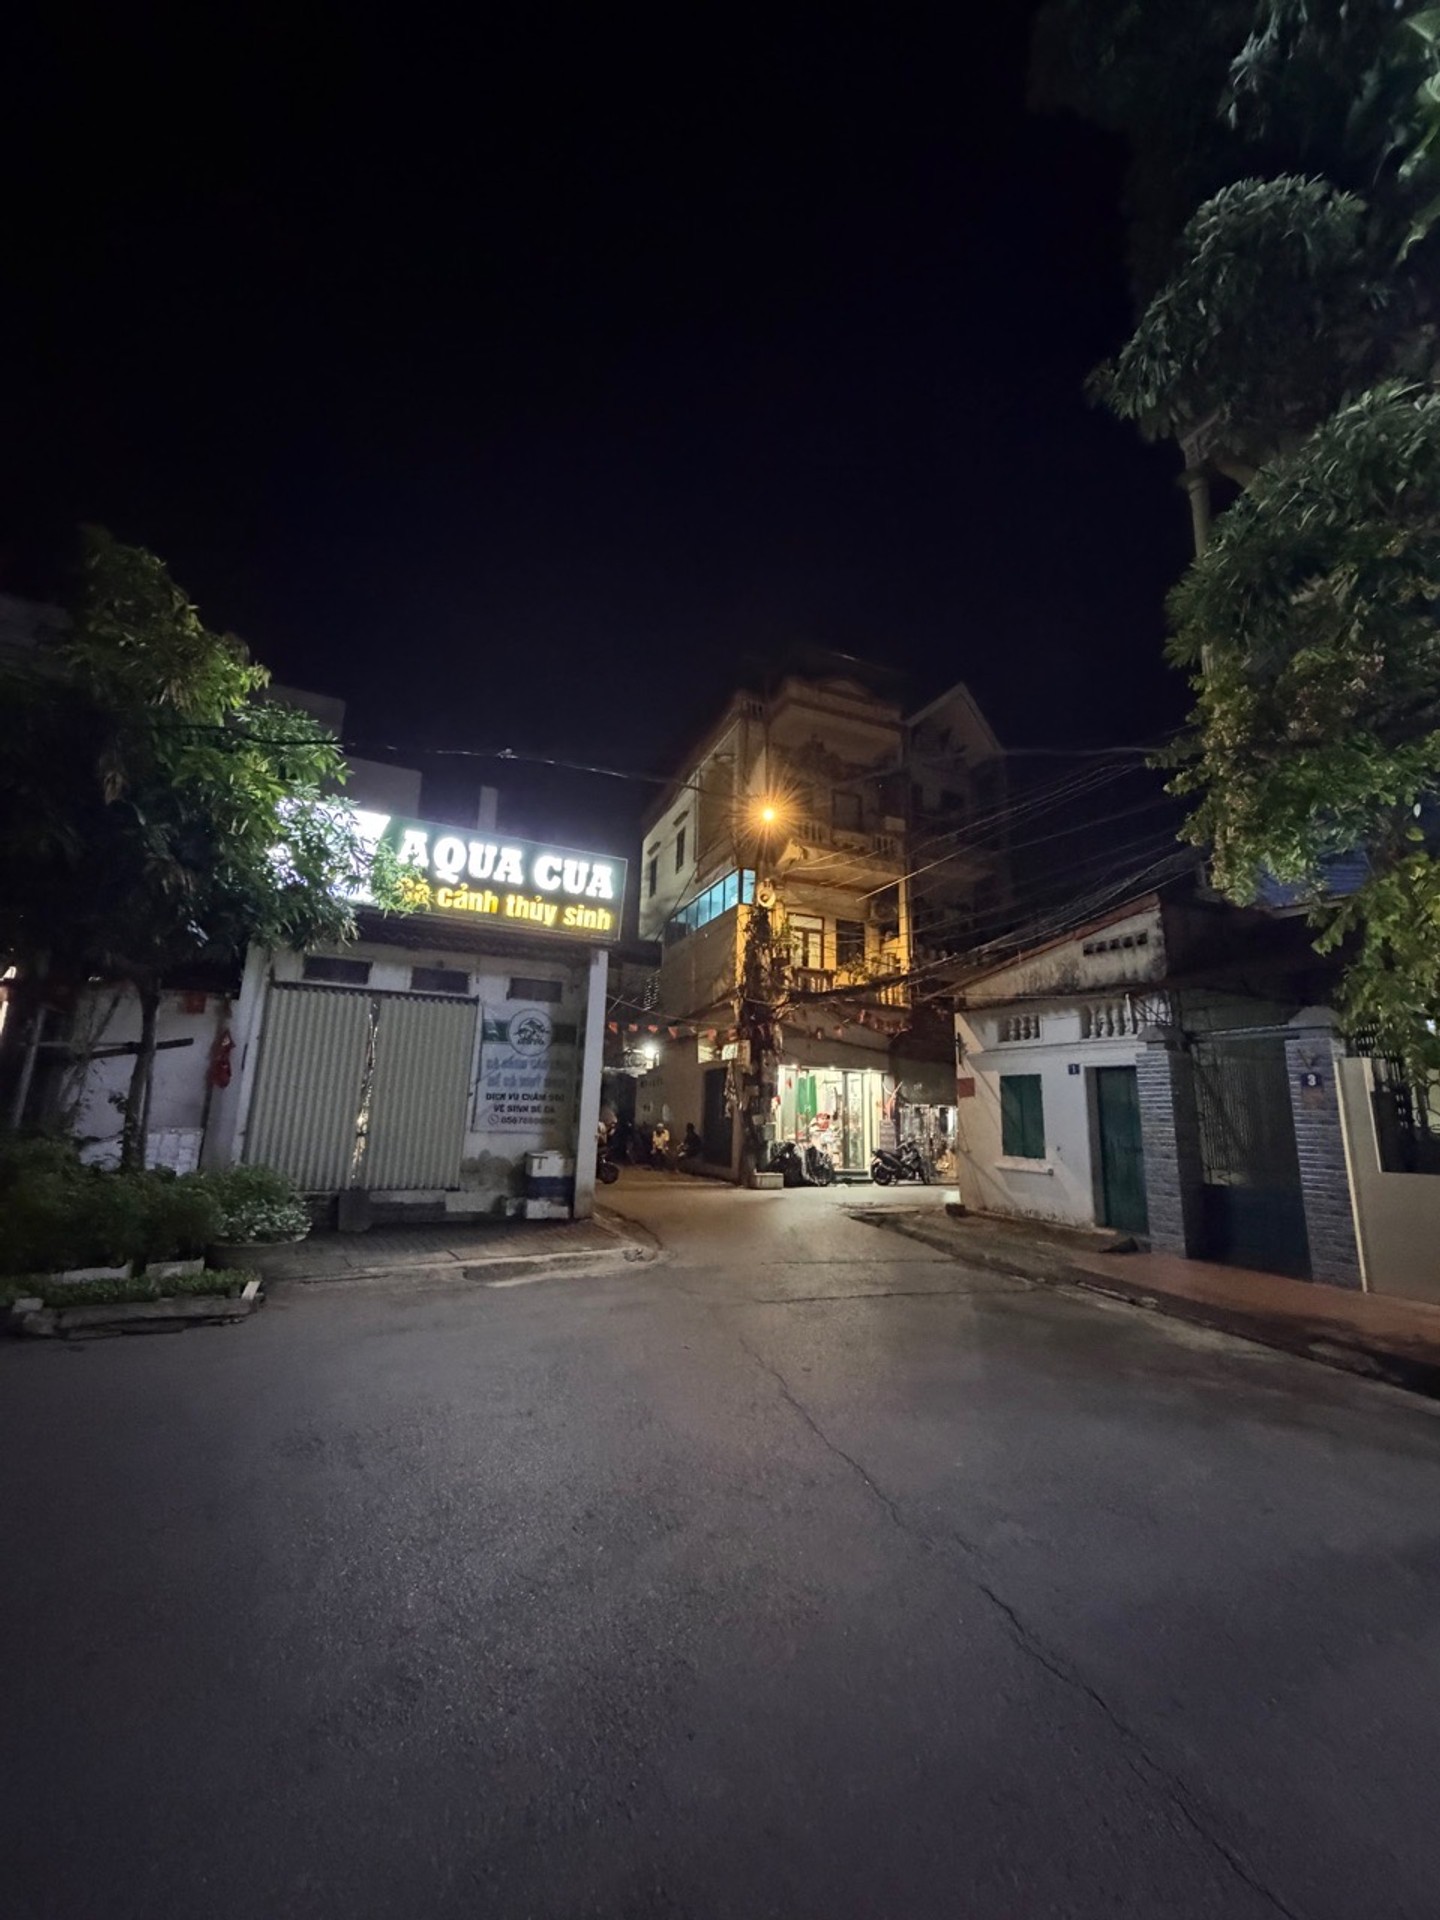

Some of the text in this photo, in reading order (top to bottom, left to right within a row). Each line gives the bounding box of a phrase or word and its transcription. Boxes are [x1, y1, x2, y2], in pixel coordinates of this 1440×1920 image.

[399, 829, 614, 900] AQUA CUA
[437, 881, 498, 915] cảnh
[506, 893, 557, 927] thủy
[563, 903, 612, 931] sinh
[1307, 1074, 1316, 1086] 3
